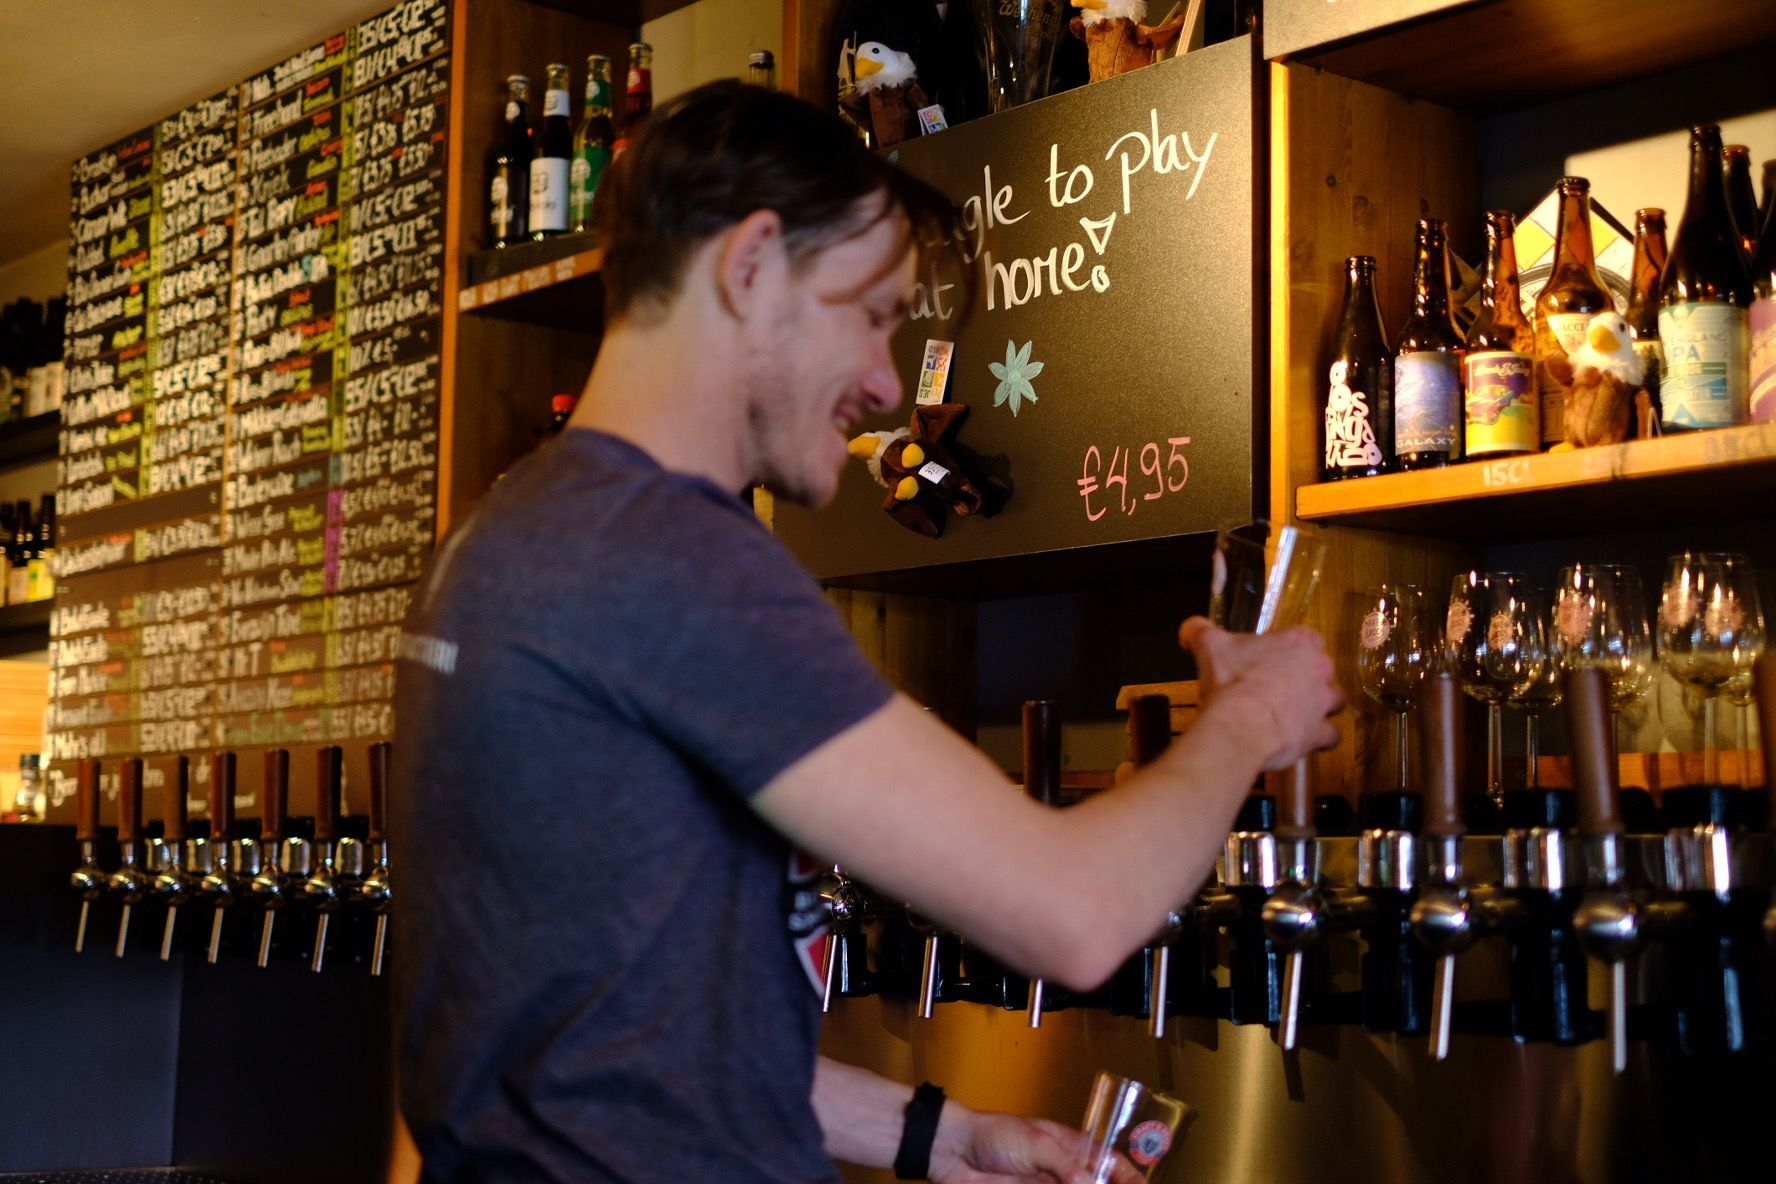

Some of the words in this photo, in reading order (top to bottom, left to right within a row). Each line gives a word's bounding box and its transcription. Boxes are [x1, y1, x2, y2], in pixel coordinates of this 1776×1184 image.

[1045, 144, 1094, 207] to
[1105, 108, 1219, 215] play
[910, 262, 955, 320] at
[1397, 438, 1456, 448] GALAXY
